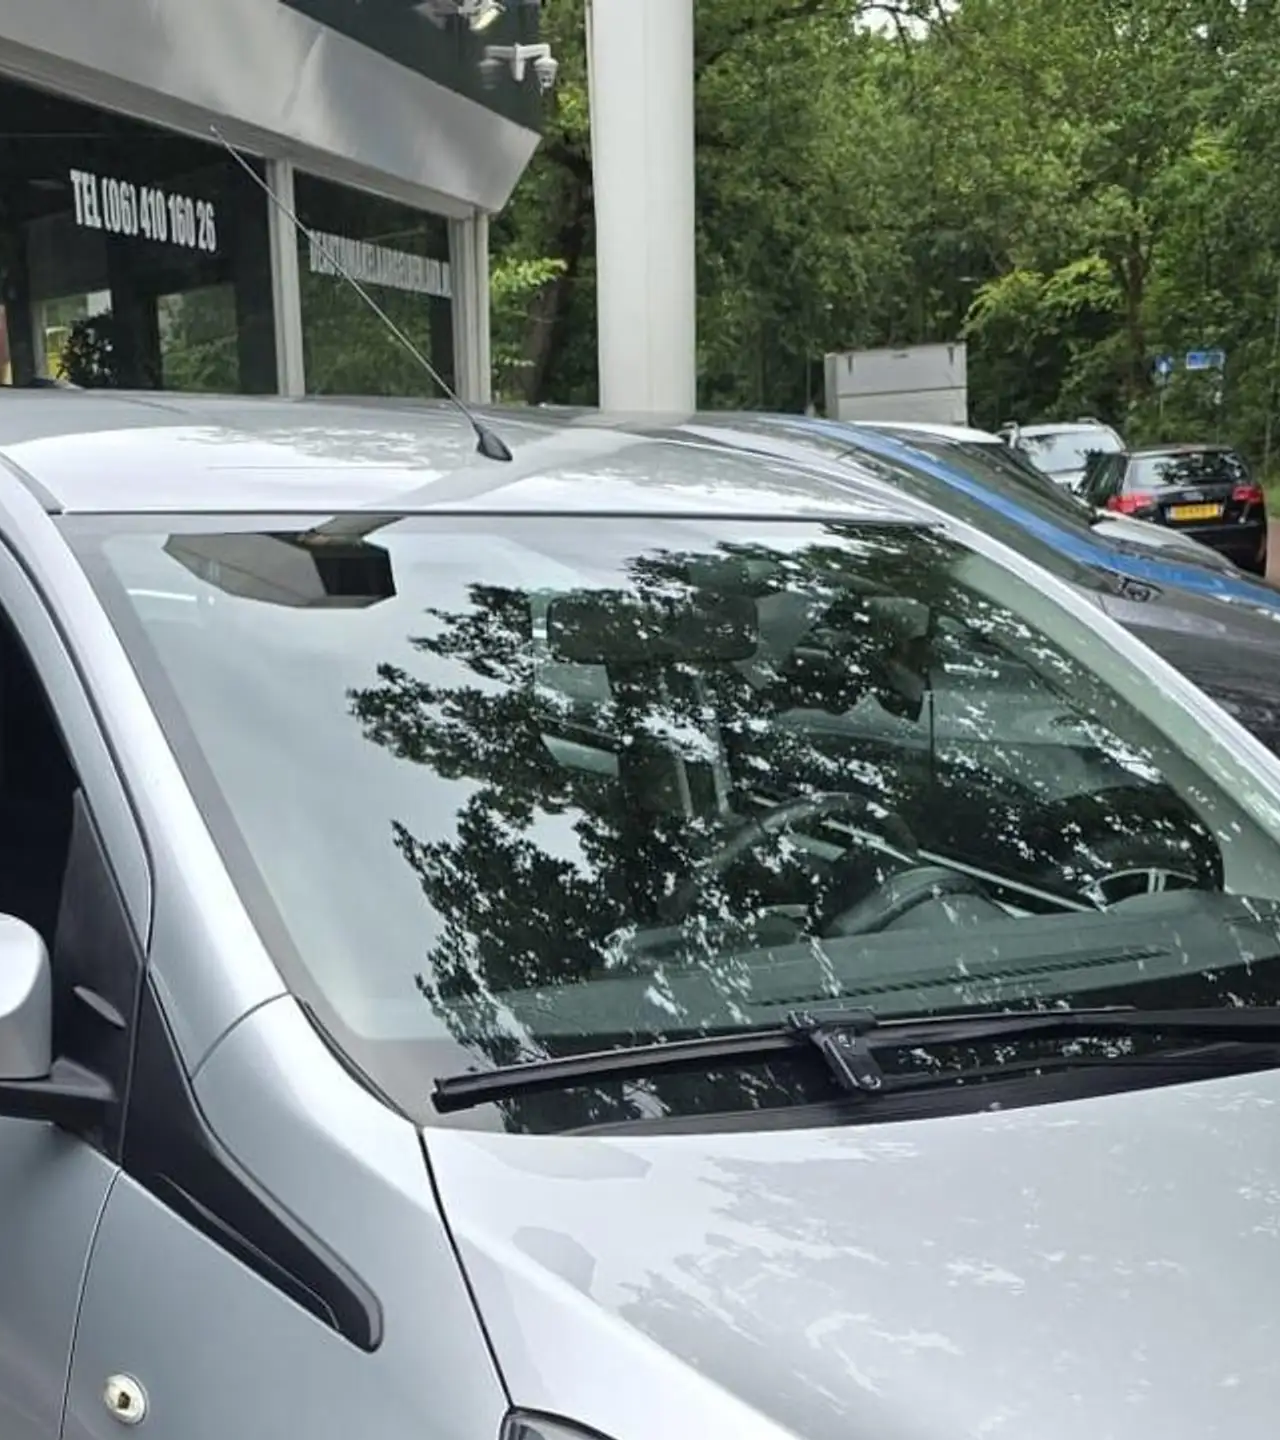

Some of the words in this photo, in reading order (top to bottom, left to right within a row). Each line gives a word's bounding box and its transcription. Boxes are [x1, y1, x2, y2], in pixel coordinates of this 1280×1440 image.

[70, 168, 102, 229] TEL
[101, 177, 138, 237] (06)
[139, 186, 168, 243] 410
[168, 193, 196, 248] 160
[196, 200, 217, 252] 26
